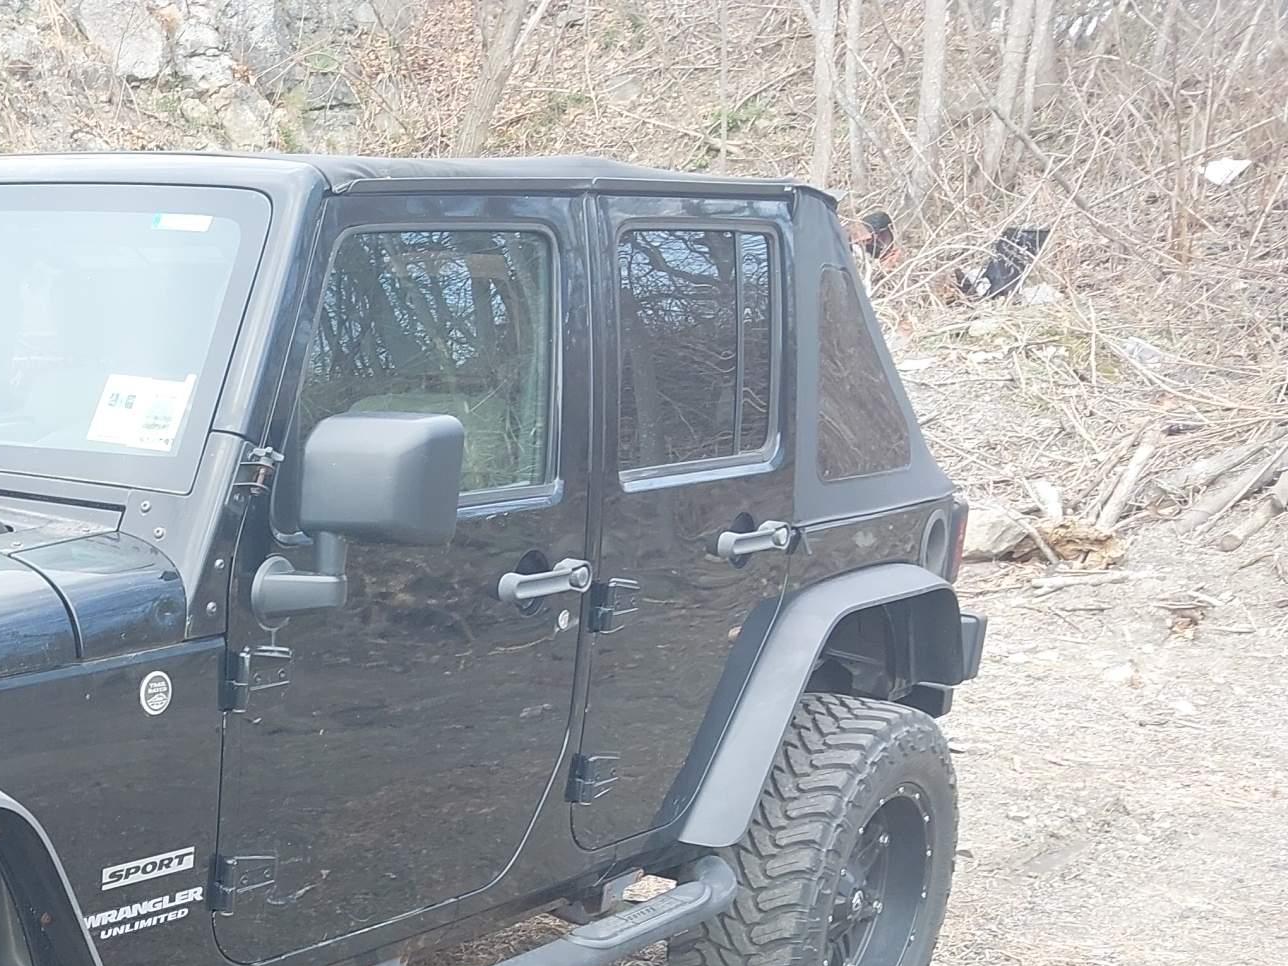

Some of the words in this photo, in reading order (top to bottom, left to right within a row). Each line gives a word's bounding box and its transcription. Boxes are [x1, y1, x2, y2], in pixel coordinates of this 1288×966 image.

[103, 851, 193, 885] SPORT
[84, 886, 204, 929] WRANGLER
[100, 908, 189, 940] UNLIMITED
